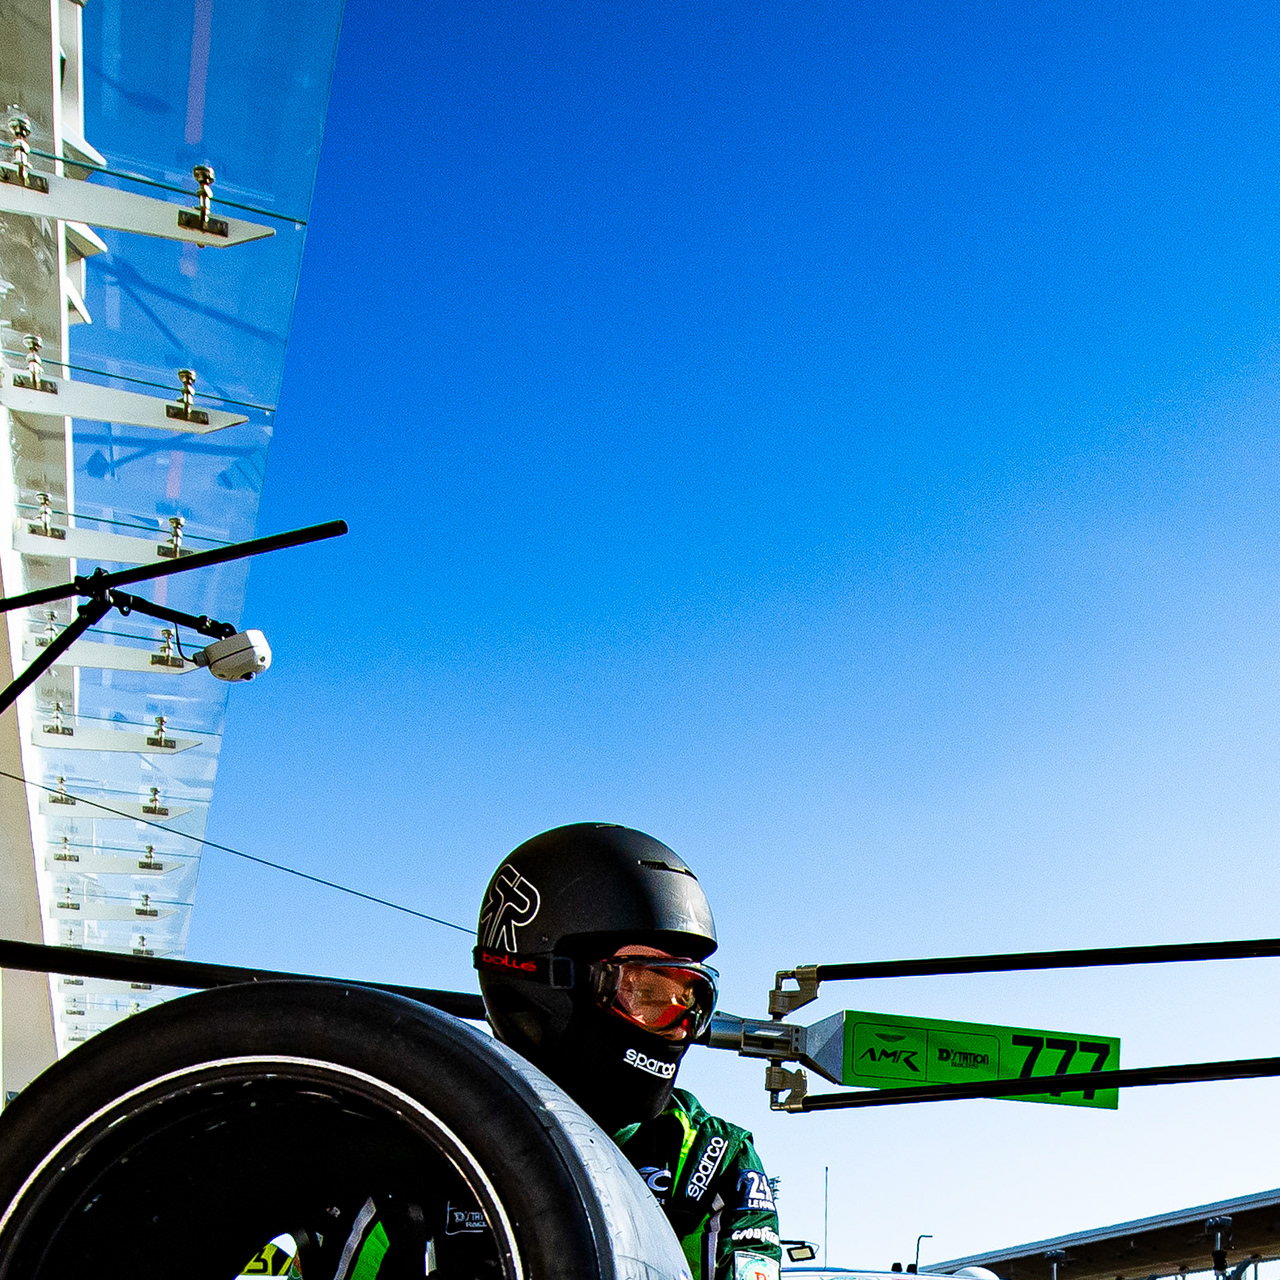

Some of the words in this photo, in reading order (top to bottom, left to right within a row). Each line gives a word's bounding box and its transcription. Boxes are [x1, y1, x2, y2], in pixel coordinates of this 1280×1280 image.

[623, 1049, 676, 1079] sparco
[859, 1047, 920, 1072] AMR
[937, 1048, 989, 1066] D'STATION
[1012, 1034, 1111, 1100] 777
[687, 1136, 728, 1202] sparco
